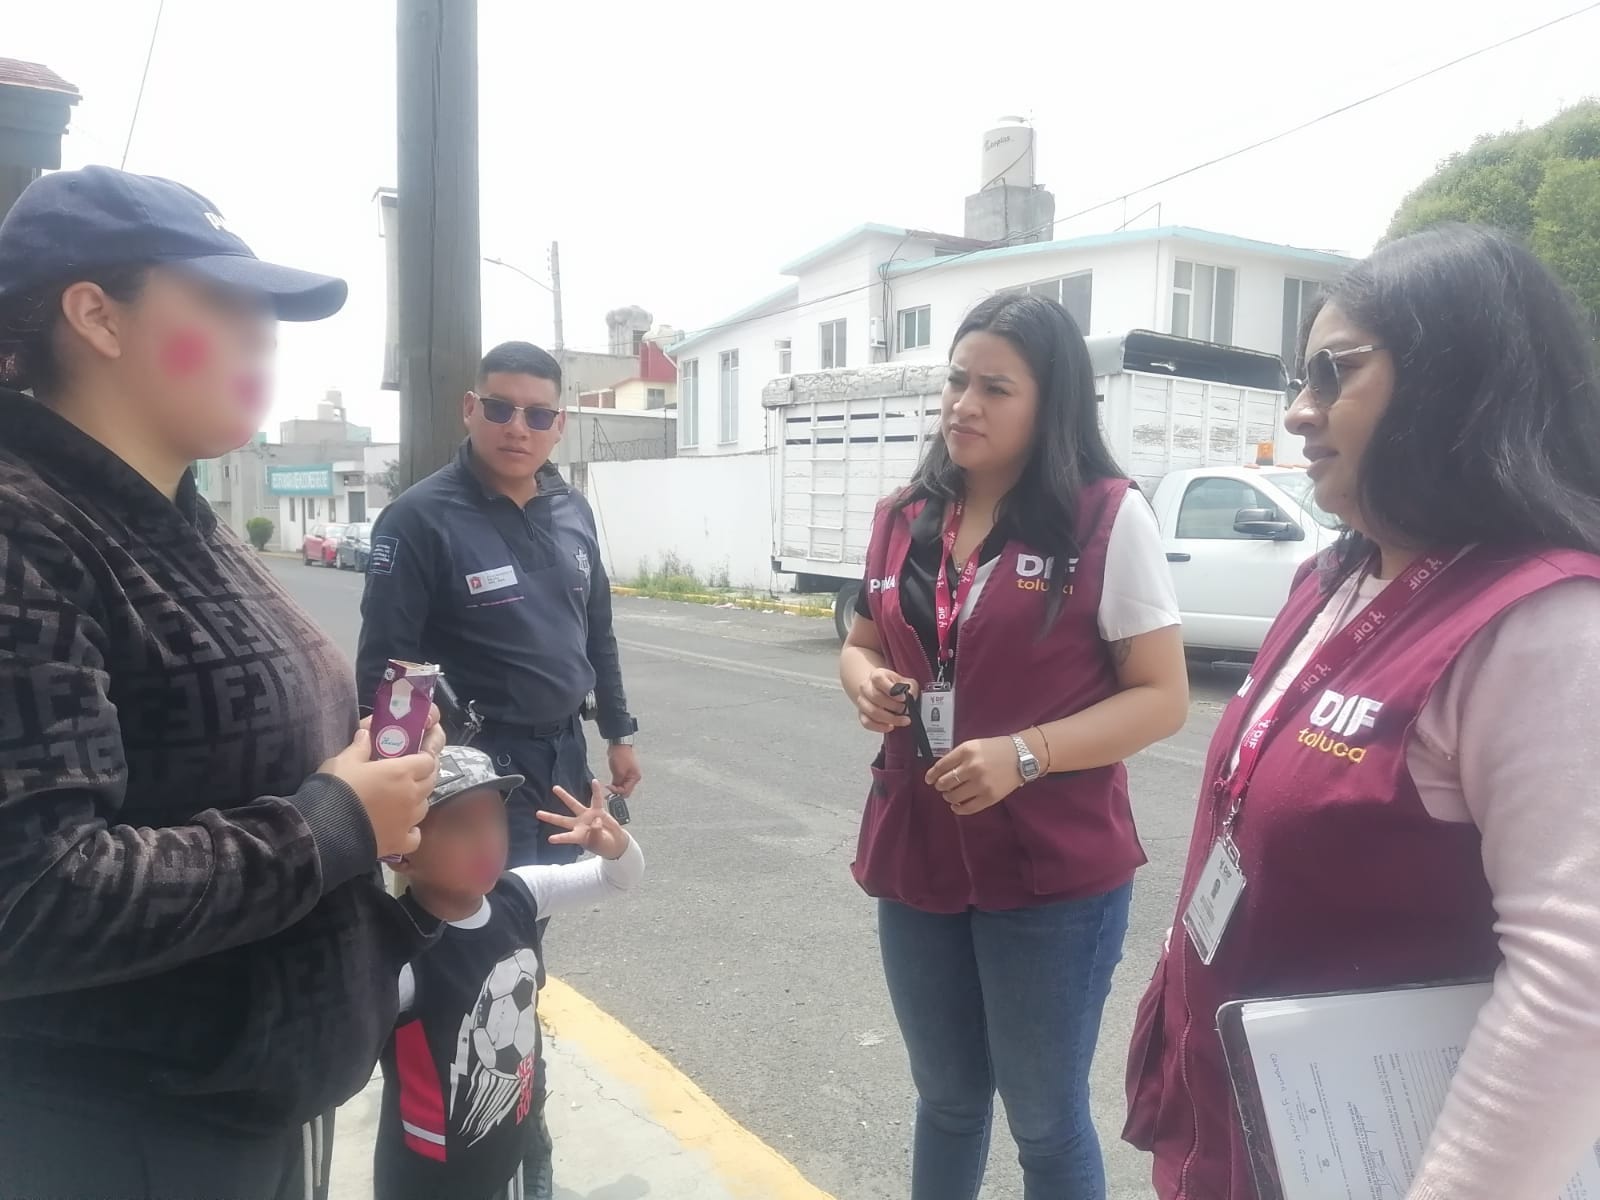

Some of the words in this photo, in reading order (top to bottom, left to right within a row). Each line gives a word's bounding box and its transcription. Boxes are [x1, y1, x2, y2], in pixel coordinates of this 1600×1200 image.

[1409, 568, 1430, 590] DIF
[1353, 622, 1373, 643] DIF
[1301, 674, 1320, 694] DIF
[1309, 689, 1384, 736] DIF
[1249, 730, 1264, 749] DIF
[1298, 727, 1367, 763] toluca
